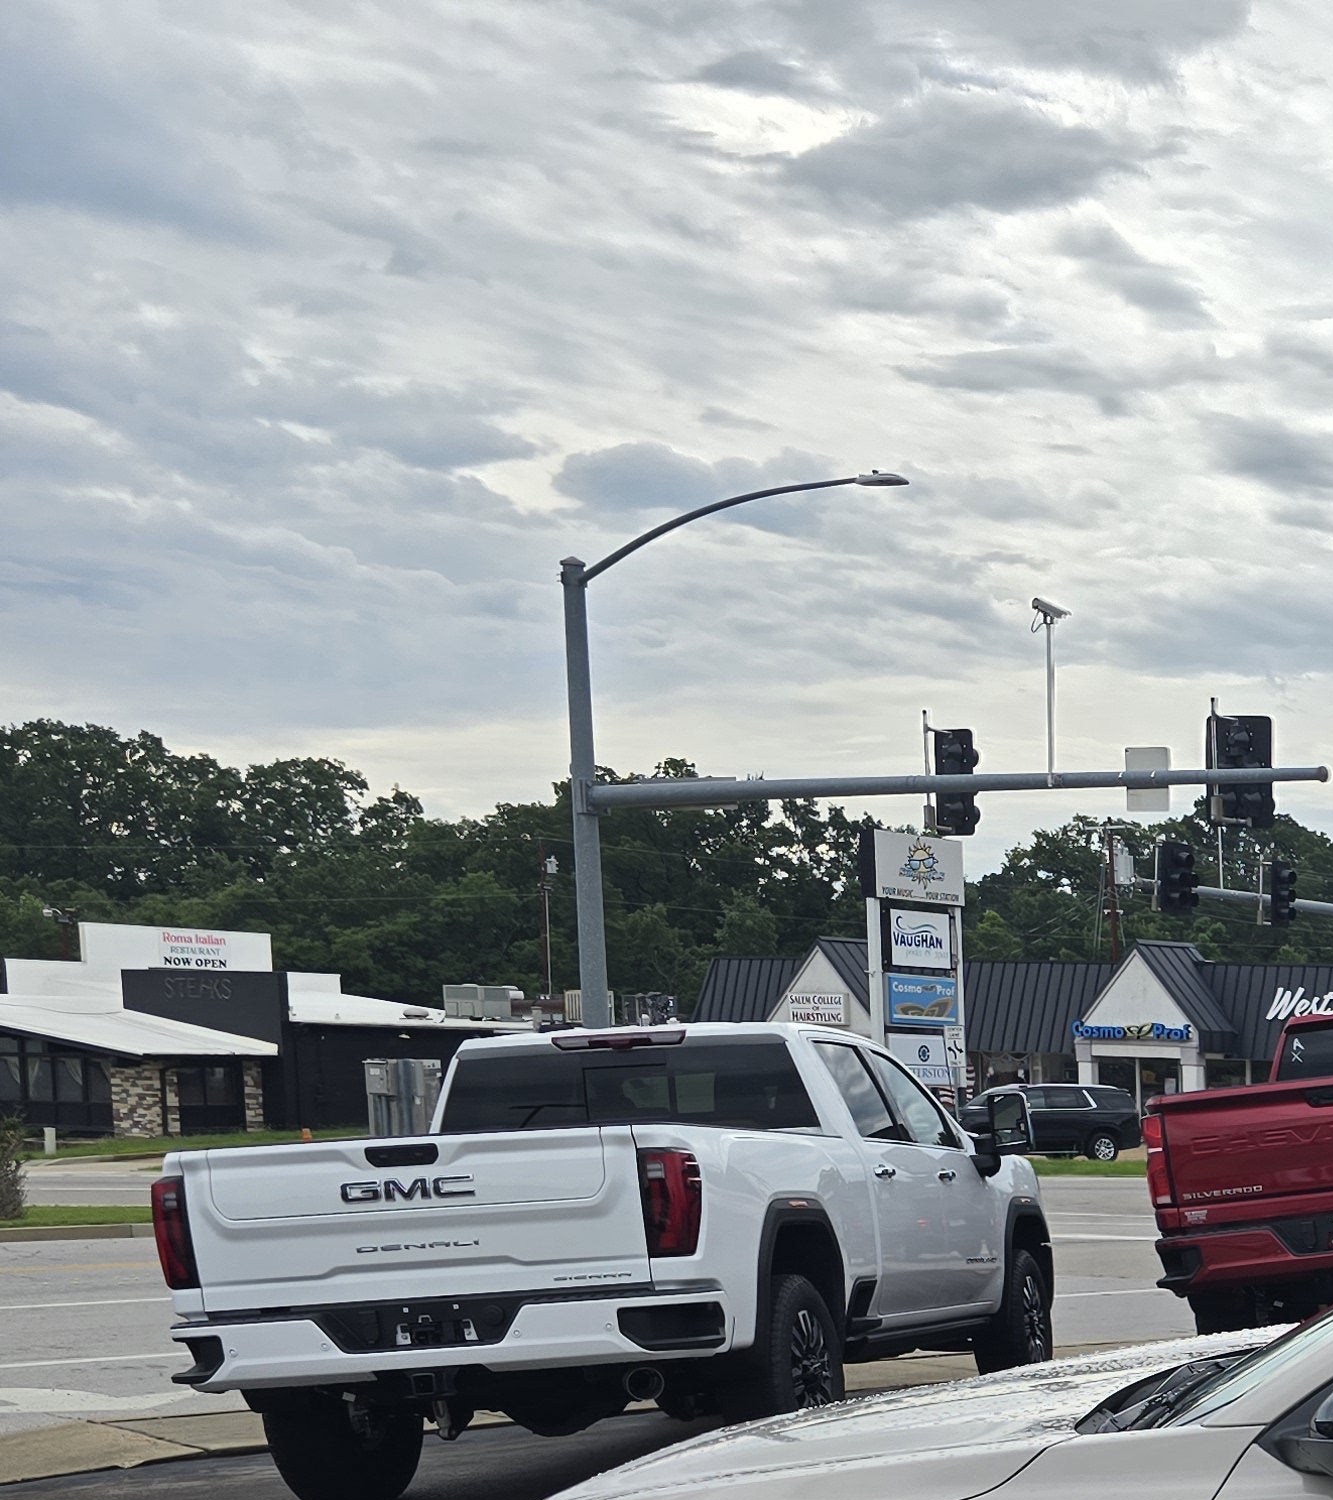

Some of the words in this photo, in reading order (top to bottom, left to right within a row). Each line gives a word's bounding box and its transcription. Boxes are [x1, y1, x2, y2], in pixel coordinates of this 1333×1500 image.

[162, 932, 193, 944] Roma
[195, 934, 226, 945] Italian
[893, 931, 943, 949] VAUGHAN
[170, 946, 221, 956] RESTAURANT
[163, 956, 192, 967] NOW
[195, 958, 227, 969] OPEN
[892, 981, 922, 994] Cosmo
[936, 985, 955, 996] Prof
[790, 995, 811, 1004] SALEM
[812, 995, 842, 1005] COLLEGE
[792, 1011, 842, 1022] HAIRSTYLING
[1072, 1021, 1126, 1038] Cosmo
[1152, 1023, 1192, 1039] Prof
[340, 1174, 476, 1203] GMC
[1183, 1184, 1264, 1200] SILVERADO
[356, 1238, 480, 1254] DENALI
[553, 1273, 632, 1281] SIERRA
